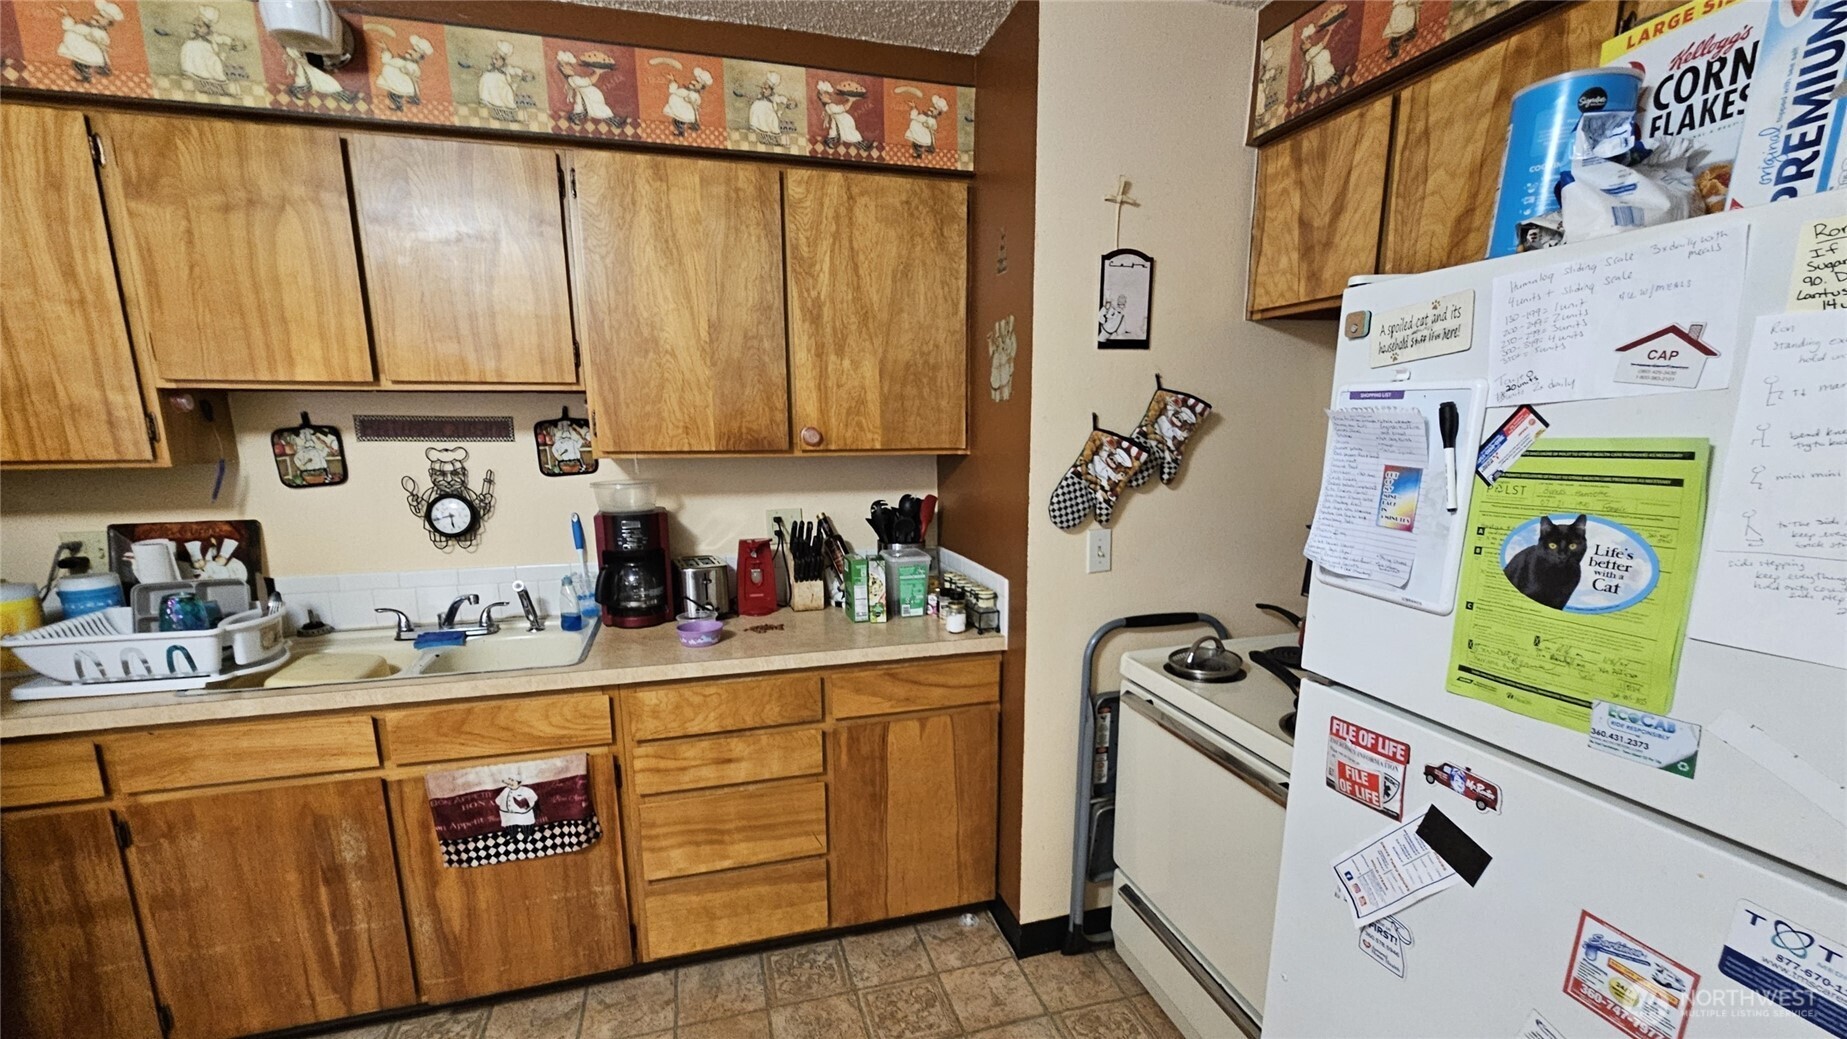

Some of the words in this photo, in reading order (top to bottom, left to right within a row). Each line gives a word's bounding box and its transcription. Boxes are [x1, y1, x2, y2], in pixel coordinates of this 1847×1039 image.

[1626, 6, 1695, 50] LARGE
[1669, 24, 1754, 72] Kellogg's
[1653, 40, 1760, 111] CORN
[1759, 125, 1789, 185] original
[1809, 242, 1839, 258] If
[1823, 299, 1837, 310] 14
[1380, 324, 1386, 336] A
[1388, 314, 1413, 339] spoiled
[1416, 313, 1429, 328] cat
[1431, 305, 1448, 324] and
[1450, 304, 1462, 320] its
[1647, 349, 1679, 361] CAP
[1594, 544, 1634, 561] Life's
[1588, 557, 1633, 573] better
[1593, 570, 1612, 579] with
[1592, 578, 1622, 595] Cat
[1332, 719, 1357, 742] FILE
[1358, 729, 1376, 748] OF
[1377, 737, 1406, 761] LIFE
[1591, 727, 1649, 750] 360.431.2373
[1345, 765, 1369, 786] FILE
[1339, 779, 1353, 794] OF
[1354, 784, 1380, 806] LIFE
